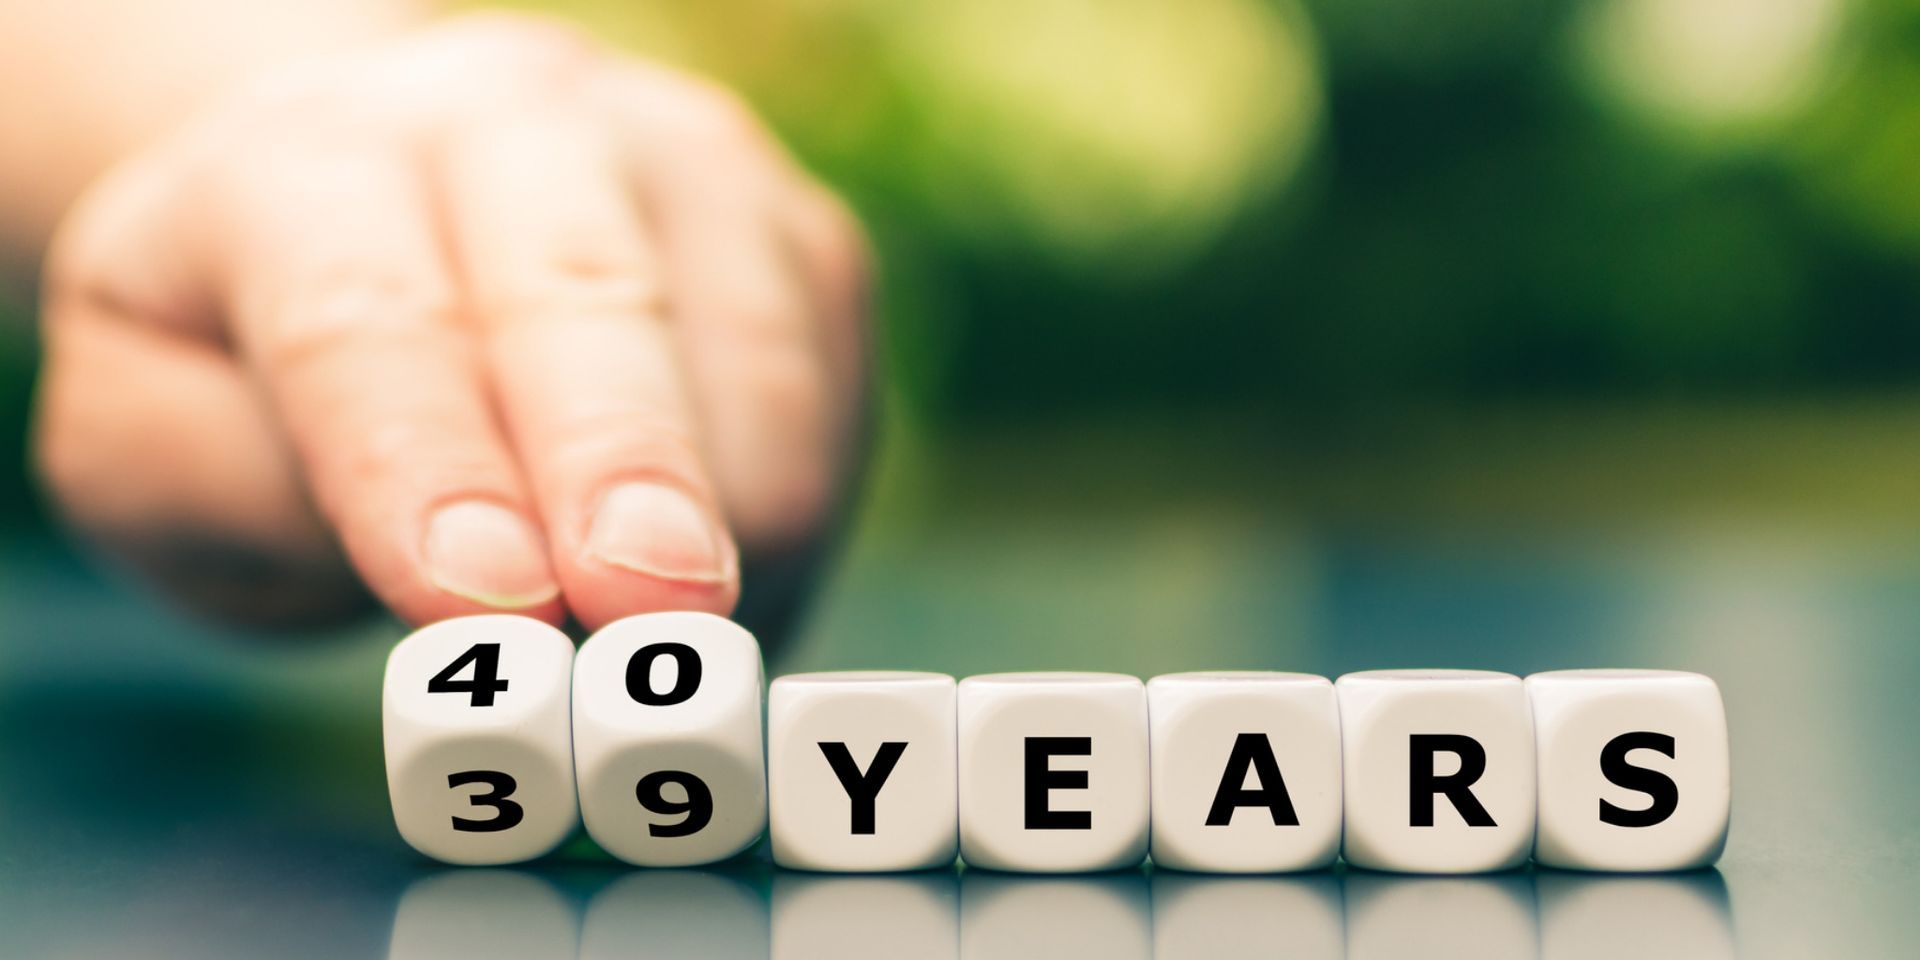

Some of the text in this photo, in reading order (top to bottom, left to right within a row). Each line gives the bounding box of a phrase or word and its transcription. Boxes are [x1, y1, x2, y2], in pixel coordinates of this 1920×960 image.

[427, 642, 703, 707] 40
[446, 732, 1679, 838] 39 YEARS
